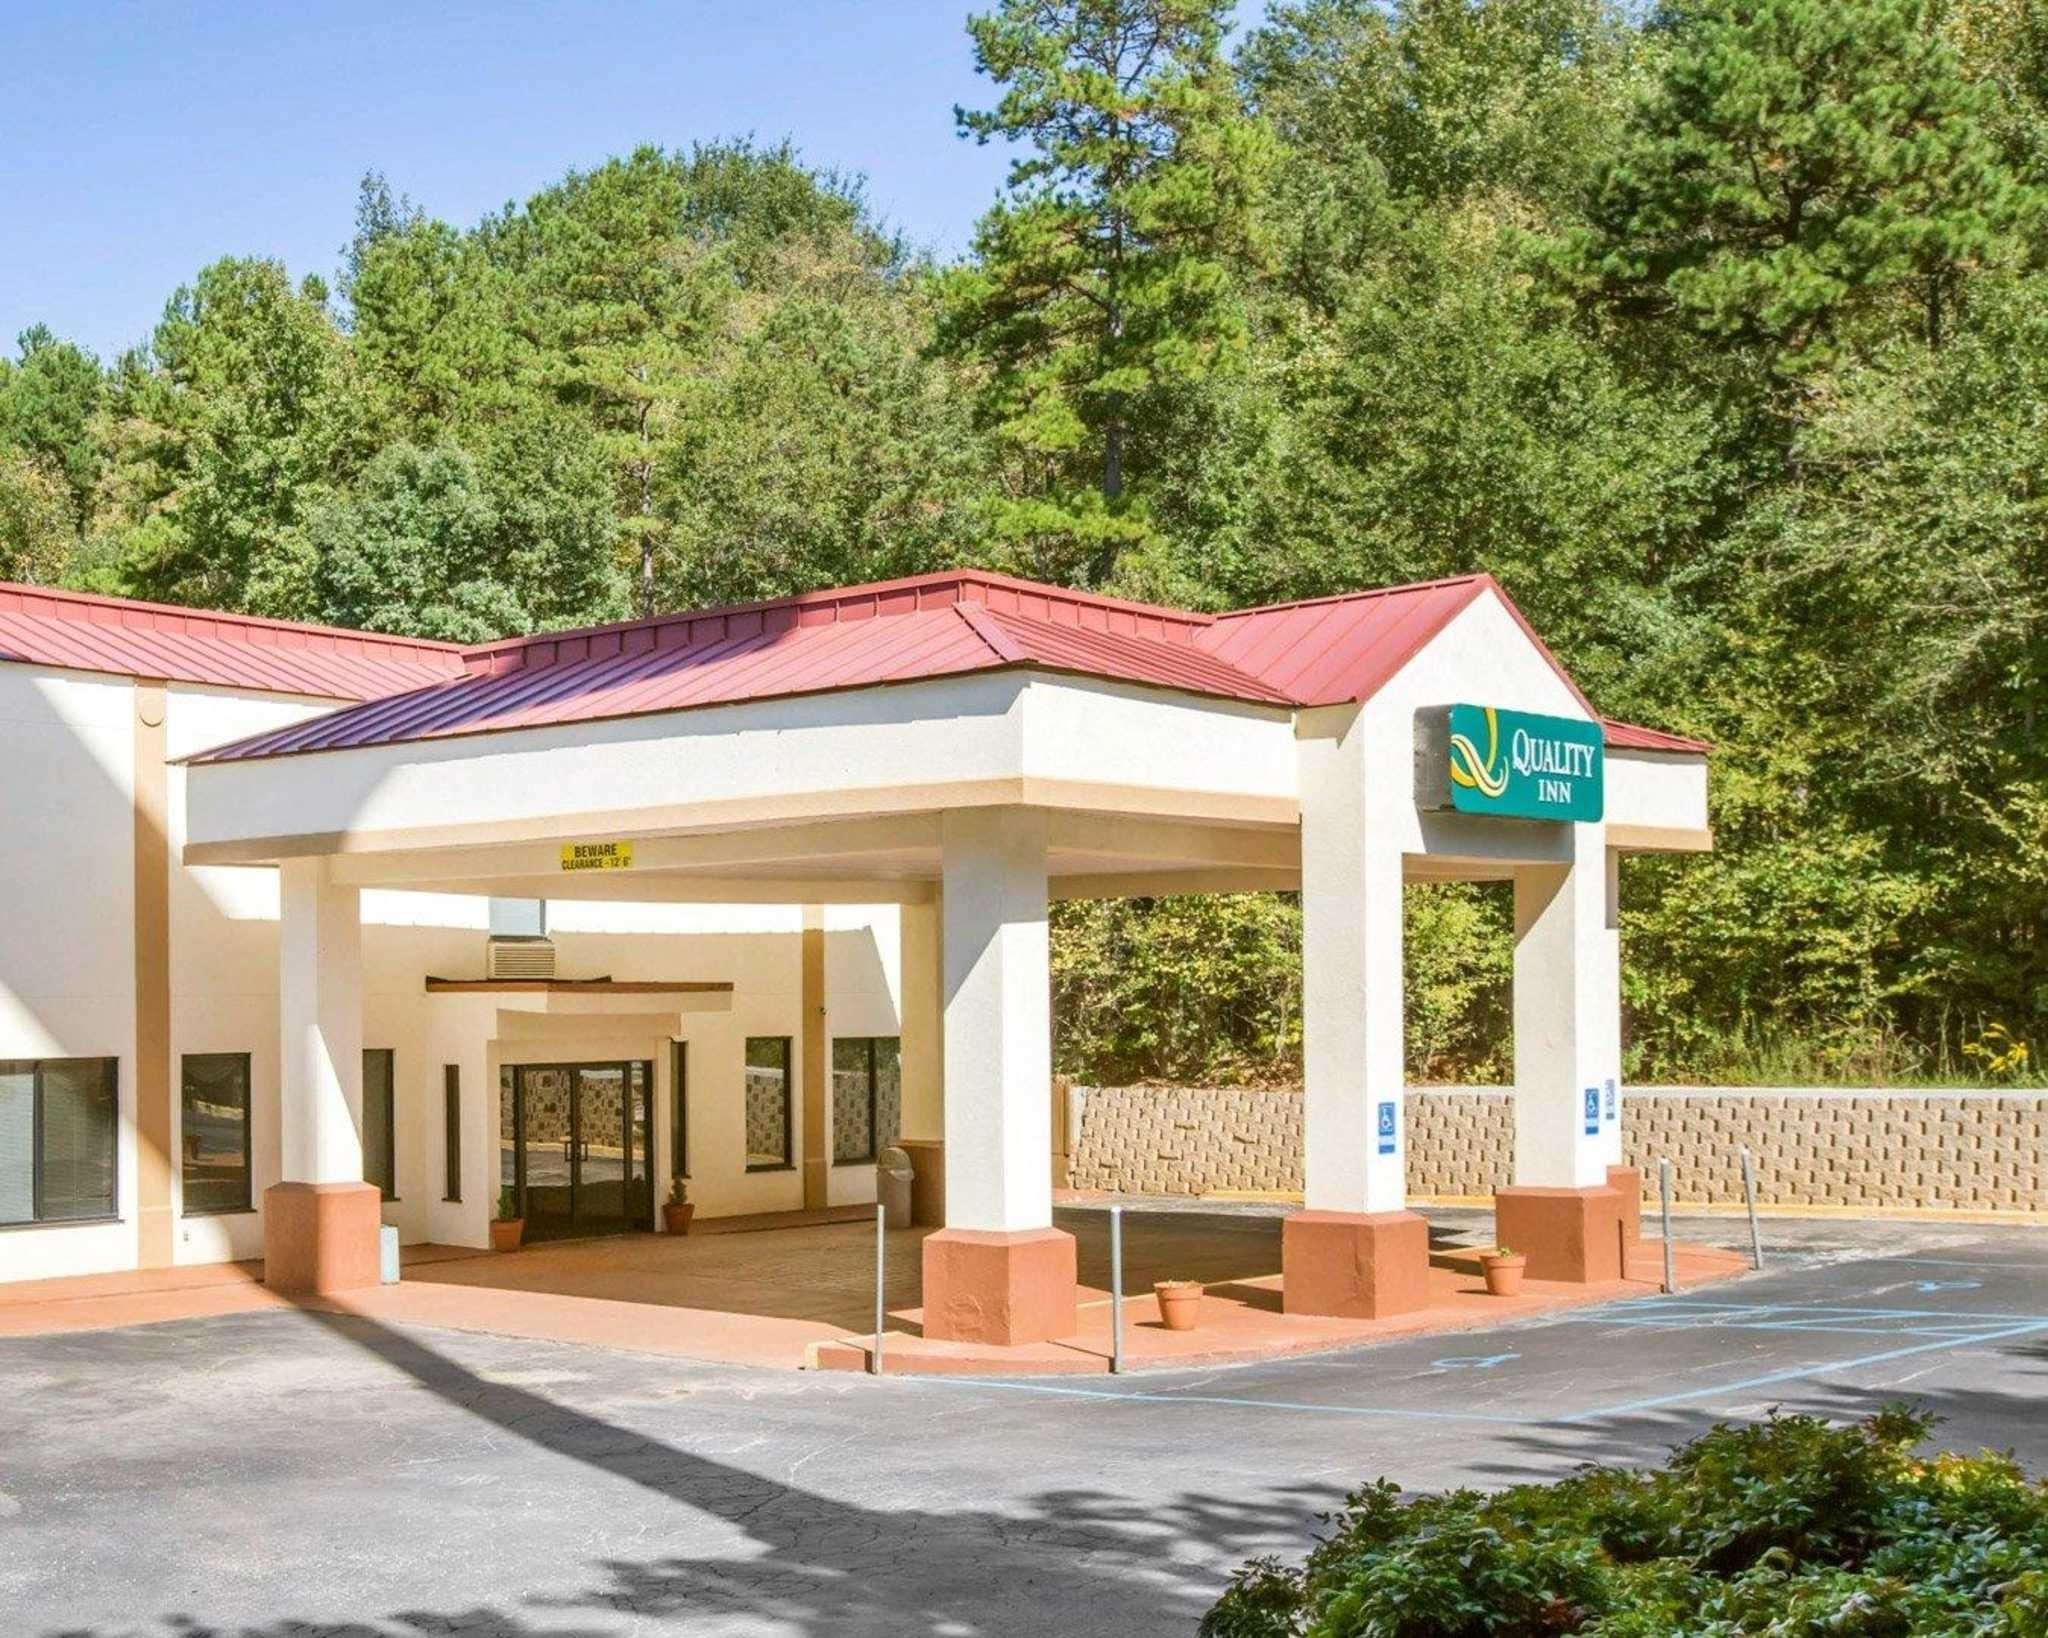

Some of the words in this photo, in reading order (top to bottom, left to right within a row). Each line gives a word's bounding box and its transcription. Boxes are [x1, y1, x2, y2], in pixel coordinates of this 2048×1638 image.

[1512, 728, 1595, 777] QUALITY
[1538, 779, 1571, 803] INN
[574, 844, 617, 858] BEWARE
[562, 858, 603, 870] CLEARANCE
